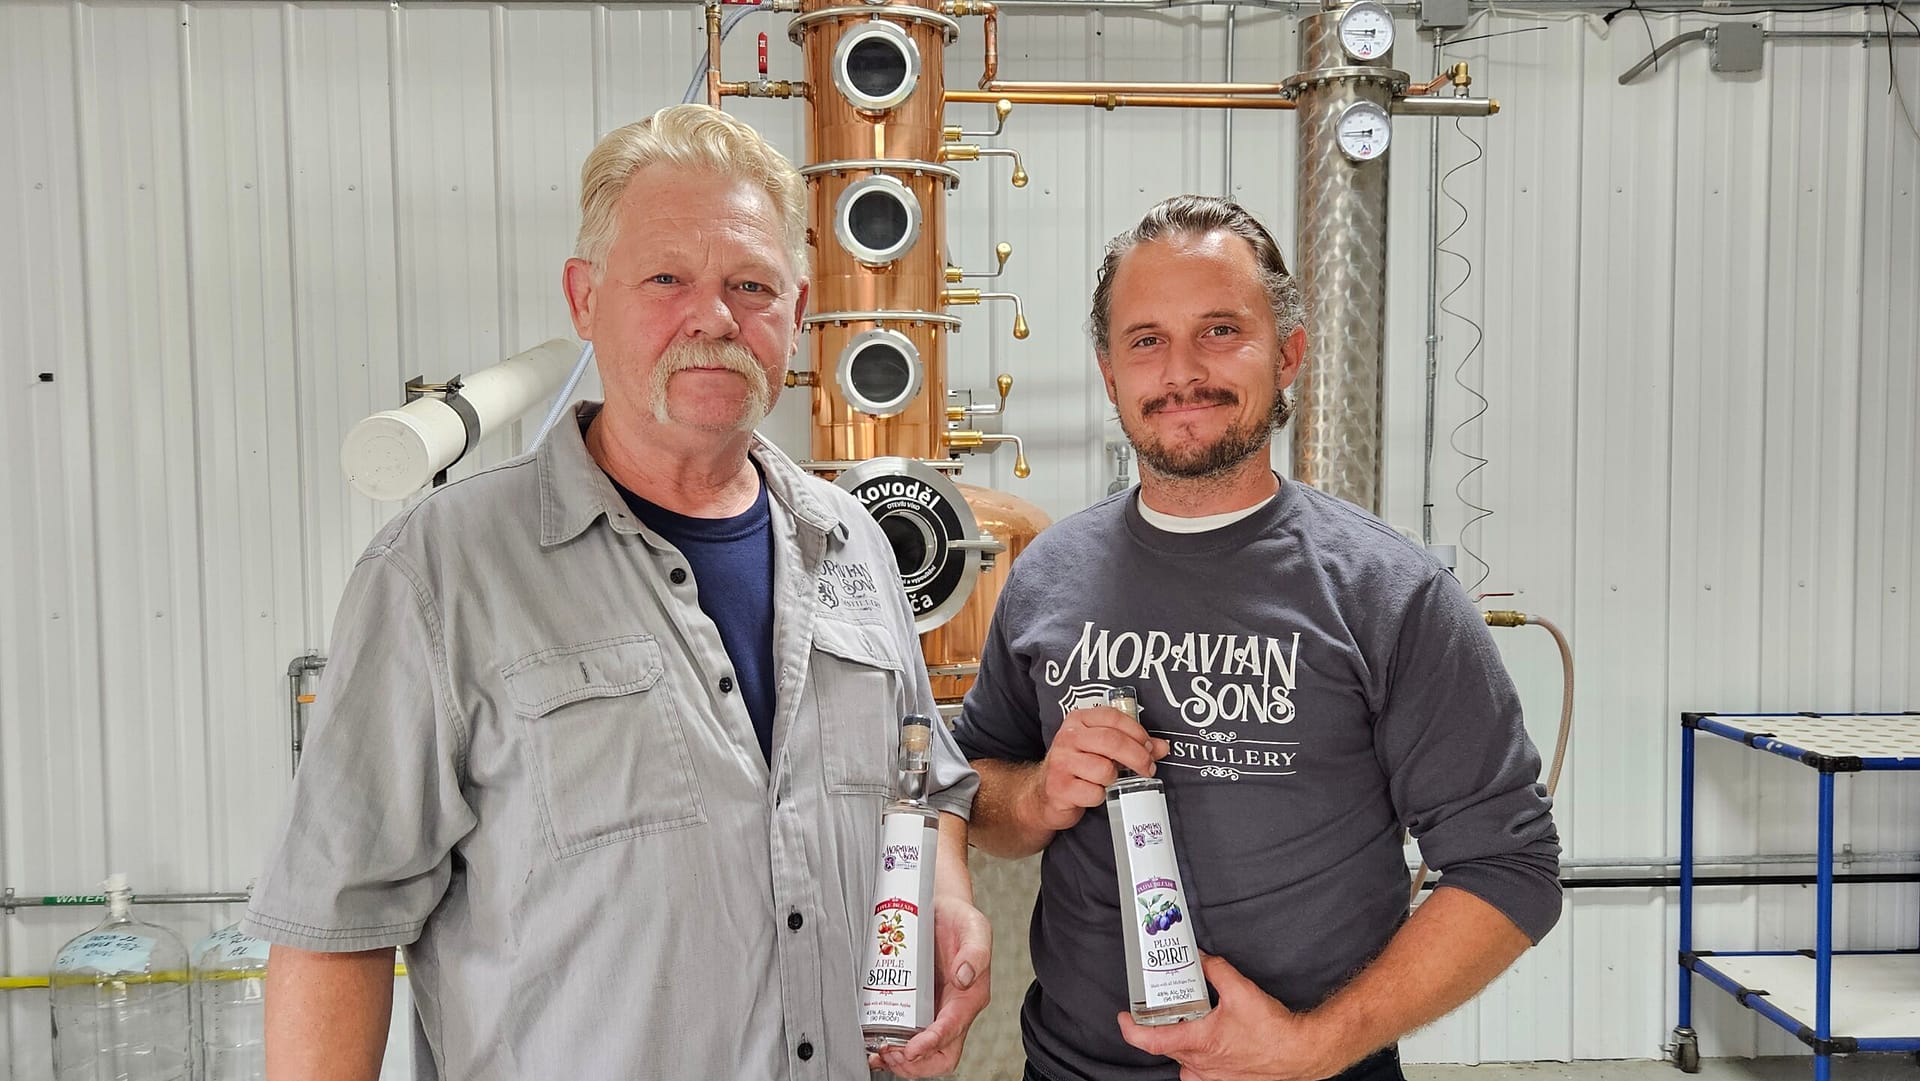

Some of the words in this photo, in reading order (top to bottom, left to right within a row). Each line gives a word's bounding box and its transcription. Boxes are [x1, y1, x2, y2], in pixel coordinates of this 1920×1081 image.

[1045, 621, 1301, 708] MORAVIAN
[1180, 676, 1296, 728] SONS
[1165, 739, 1297, 768] ISTILLERY
[56, 895, 105, 903] WATER
[1153, 937, 1180, 949] PLUM
[875, 959, 905, 969] APPLE
[1147, 945, 1189, 968] SPIRIT
[866, 968, 912, 987] SPIRIT
